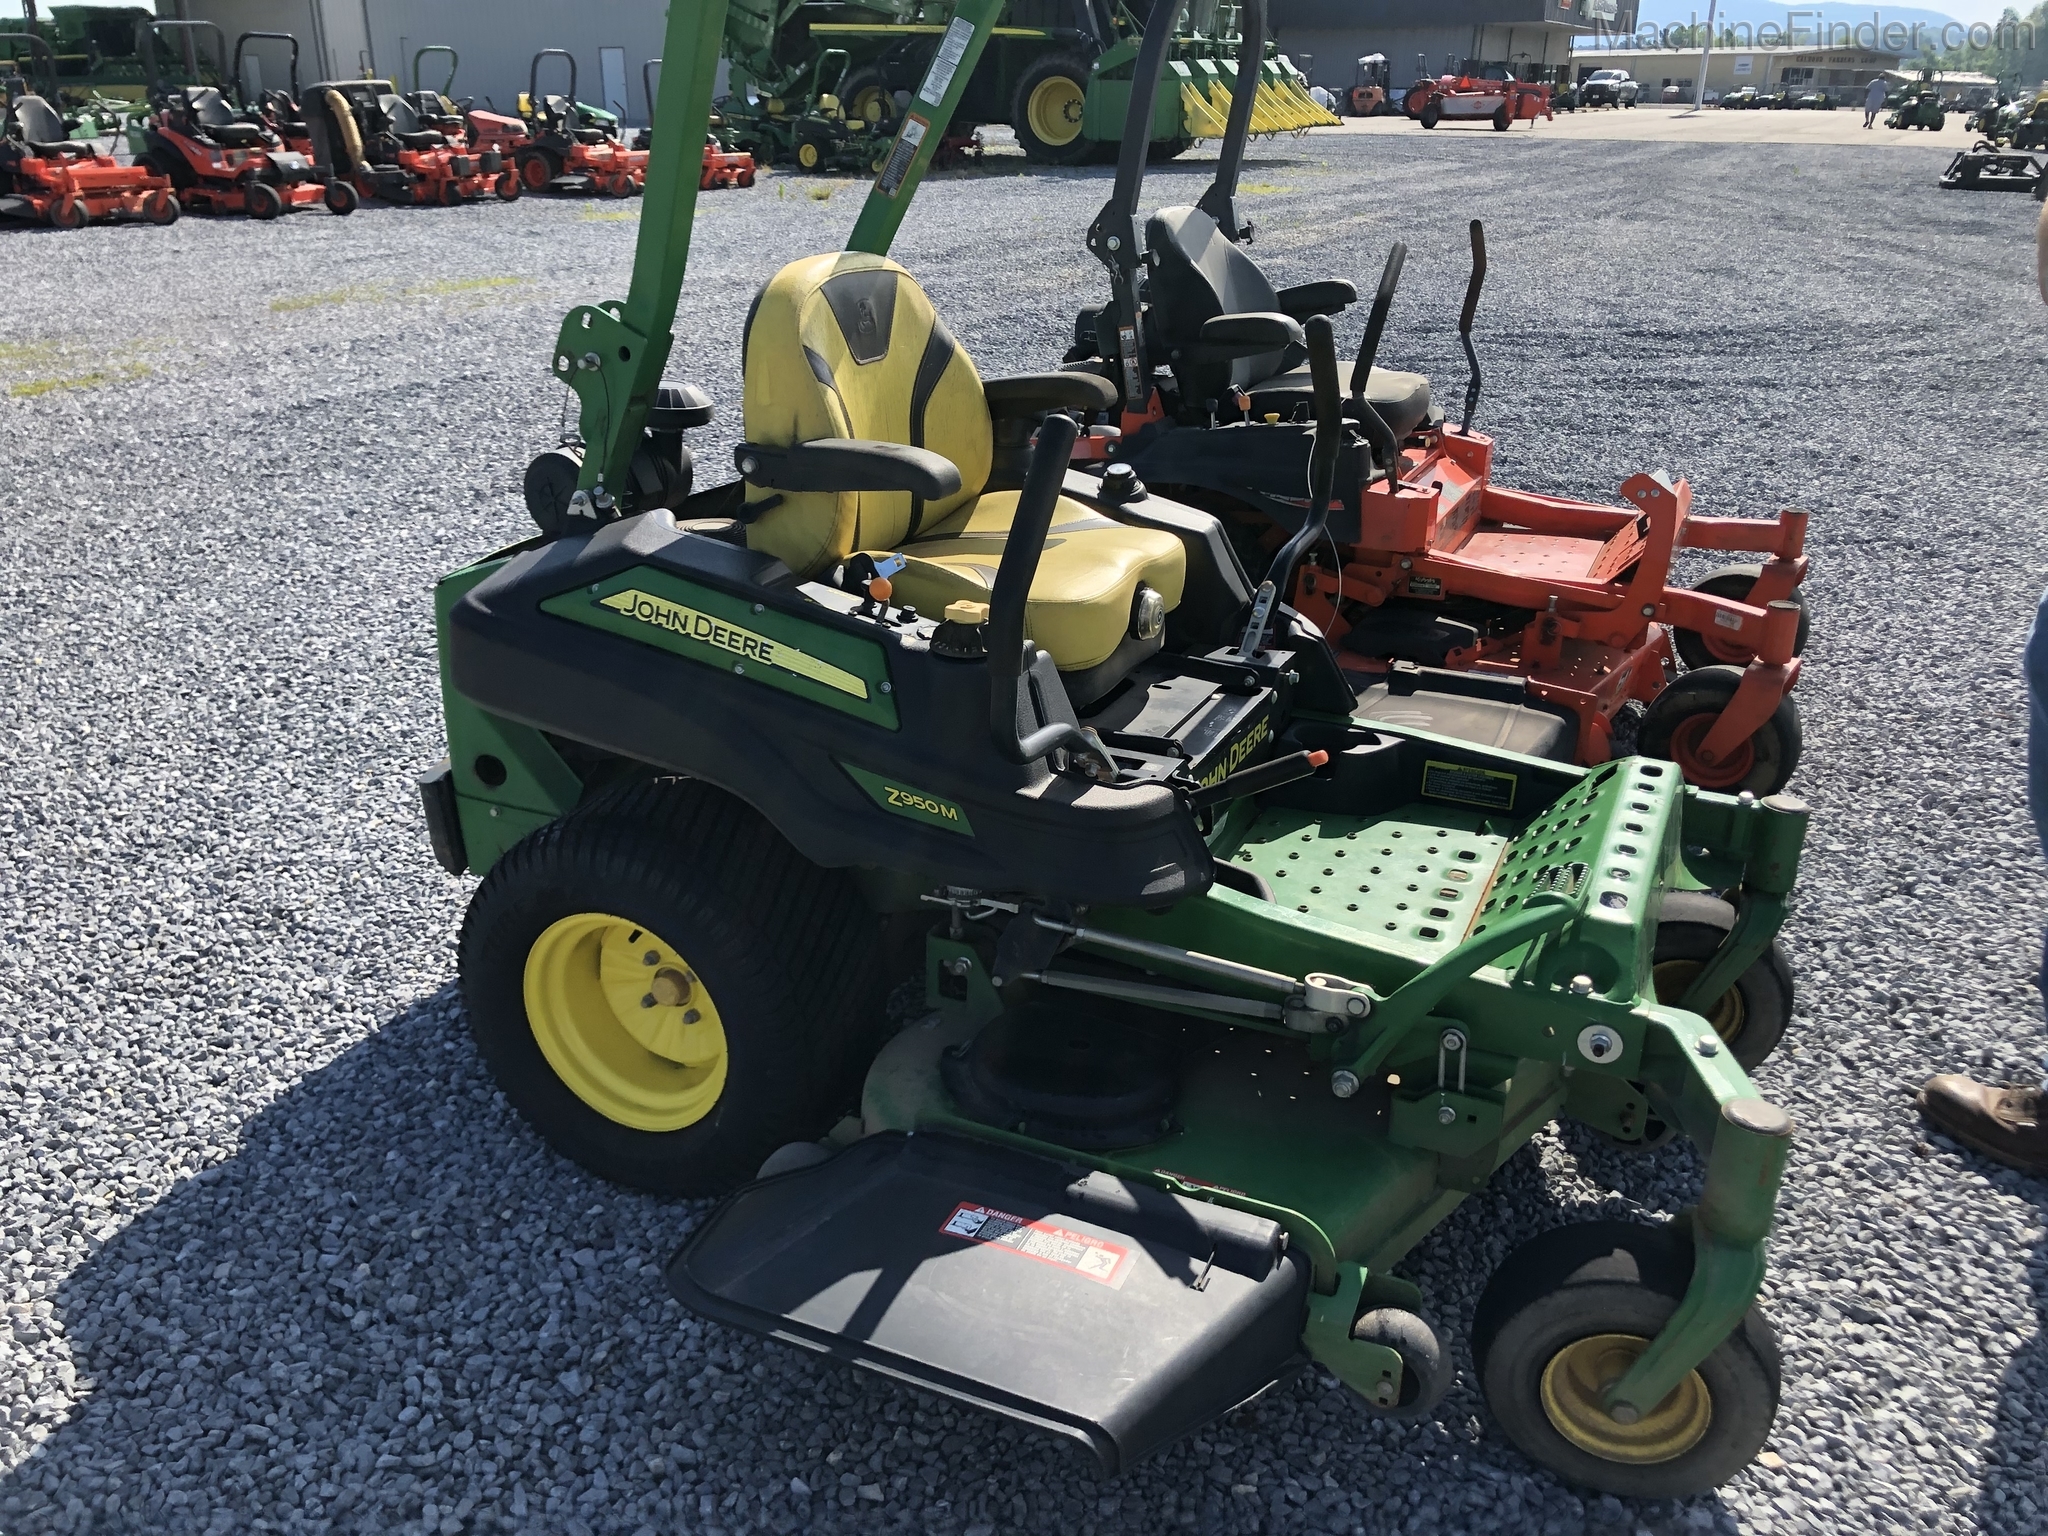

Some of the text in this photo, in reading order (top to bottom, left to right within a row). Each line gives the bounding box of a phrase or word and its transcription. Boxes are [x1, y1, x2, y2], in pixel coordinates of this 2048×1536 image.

[623, 594, 775, 663] JOHN DEERE
[1201, 757, 1227, 788] OHN
[1229, 714, 1270, 773] DEERE
[985, 1208, 1024, 1225] DANGER
[1063, 1230, 1105, 1249] PELIGRO
